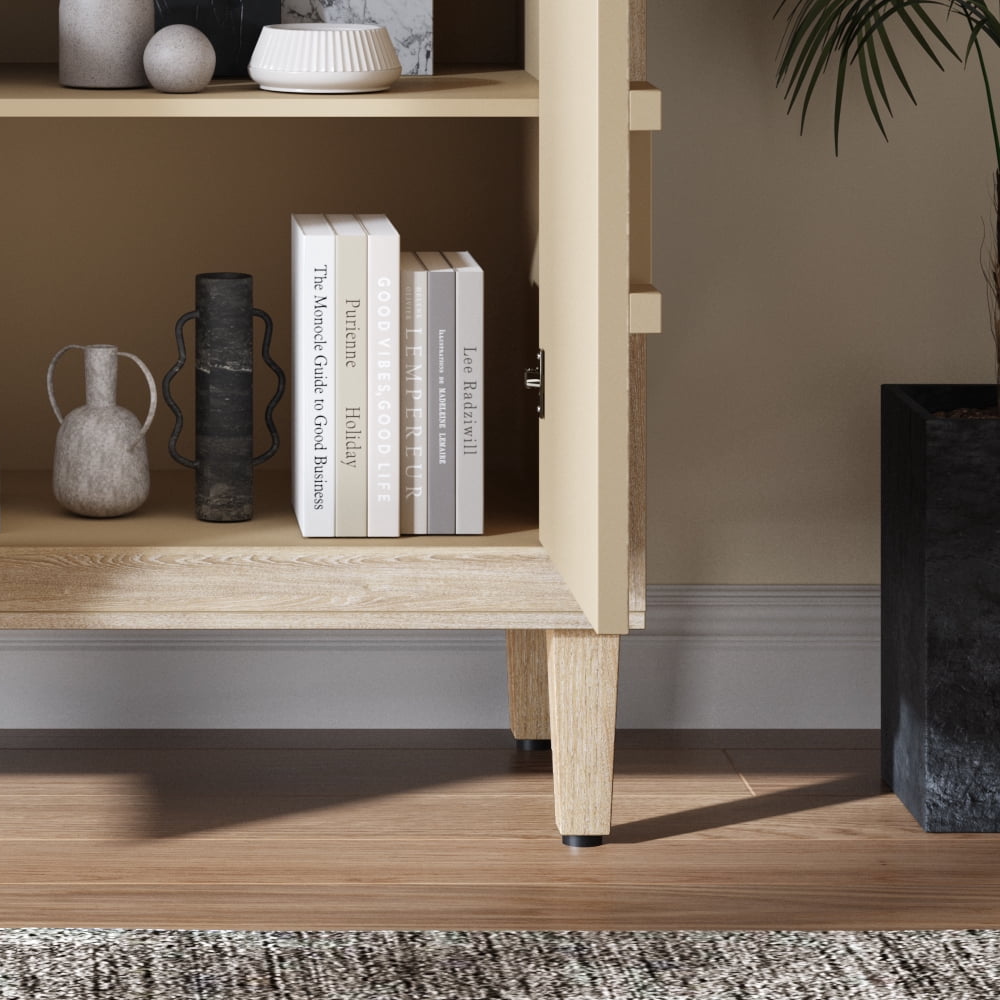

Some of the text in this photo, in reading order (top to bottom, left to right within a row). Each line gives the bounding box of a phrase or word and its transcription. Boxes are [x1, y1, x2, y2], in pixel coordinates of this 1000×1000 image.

[377, 277, 391, 330] GOOD
[313, 264, 328, 510] The Monocle Guide to Good Business
[340, 299, 362, 468] Purienne Holiday
[438, 387, 446, 428] MADELEINE
[463, 347, 477, 455] Lee Radziwill
[377, 400, 391, 454] GOOD
[405, 327, 422, 499] LEMPEREUR
[438, 432, 446, 465] LEMAIRE
[377, 463, 391, 502] LIFE
